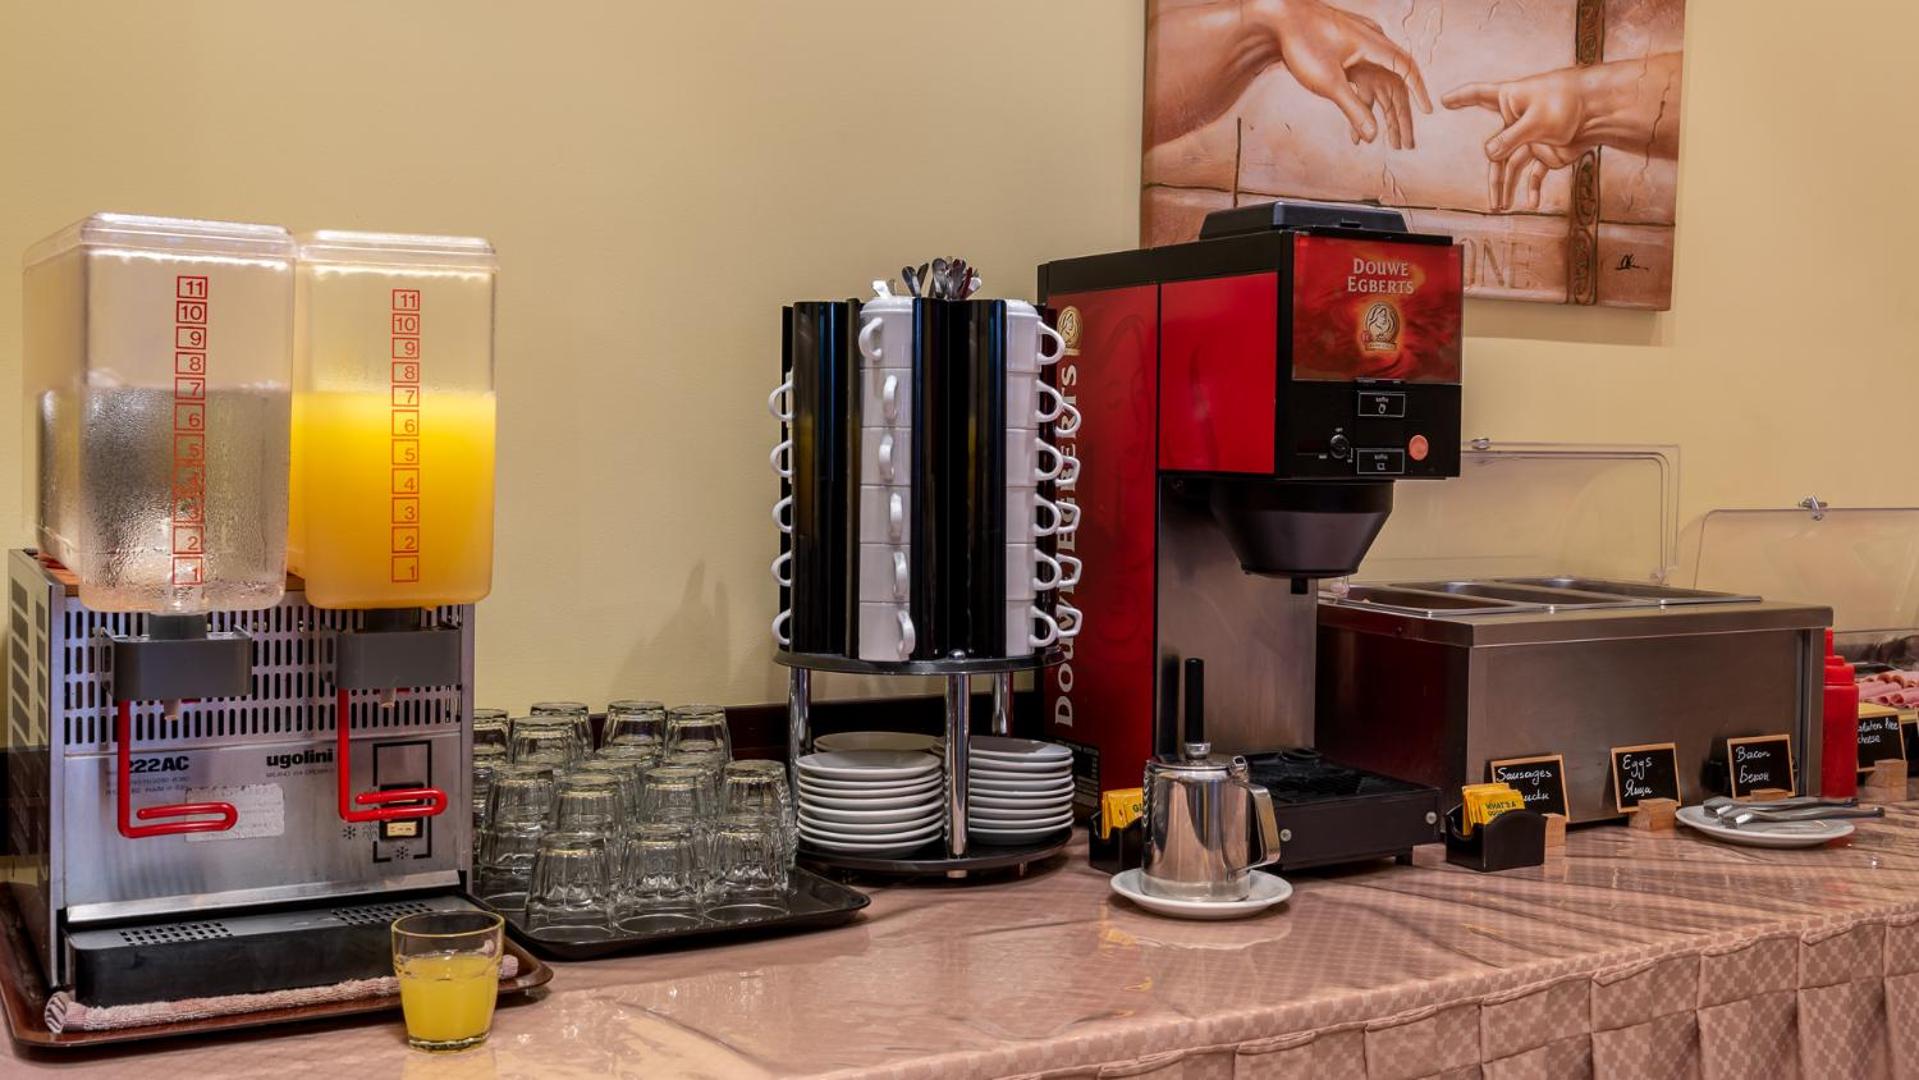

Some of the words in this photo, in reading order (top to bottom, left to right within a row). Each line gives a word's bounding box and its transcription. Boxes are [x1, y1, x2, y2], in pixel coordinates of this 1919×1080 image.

[1353, 258, 1409, 276] DOUWE
[186, 281, 203, 295] 11
[1348, 276, 1415, 295] EGBERTS
[401, 294, 416, 308] 11
[181, 305, 203, 320] 10
[396, 317, 416, 331] 10
[189, 331, 201, 345] 9
[404, 341, 416, 356] 9
[189, 357, 201, 371] 8
[404, 365, 416, 380] 8
[189, 382, 201, 397] 7
[405, 389, 416, 404] 7
[189, 412, 200, 428] 6
[404, 419, 416, 433] 6
[404, 447, 416, 462] 5
[404, 477, 415, 491] 4
[404, 506, 415, 520] 3
[187, 536, 199, 551] 2
[404, 535, 415, 550] 2
[191, 567, 199, 582] 1
[408, 566, 415, 579] 1
[266, 748, 334, 769] ugolini
[1736, 746, 1770, 762] Bacon
[1622, 754, 1652, 780] Eggs
[1496, 768, 1552, 785] Sausages
